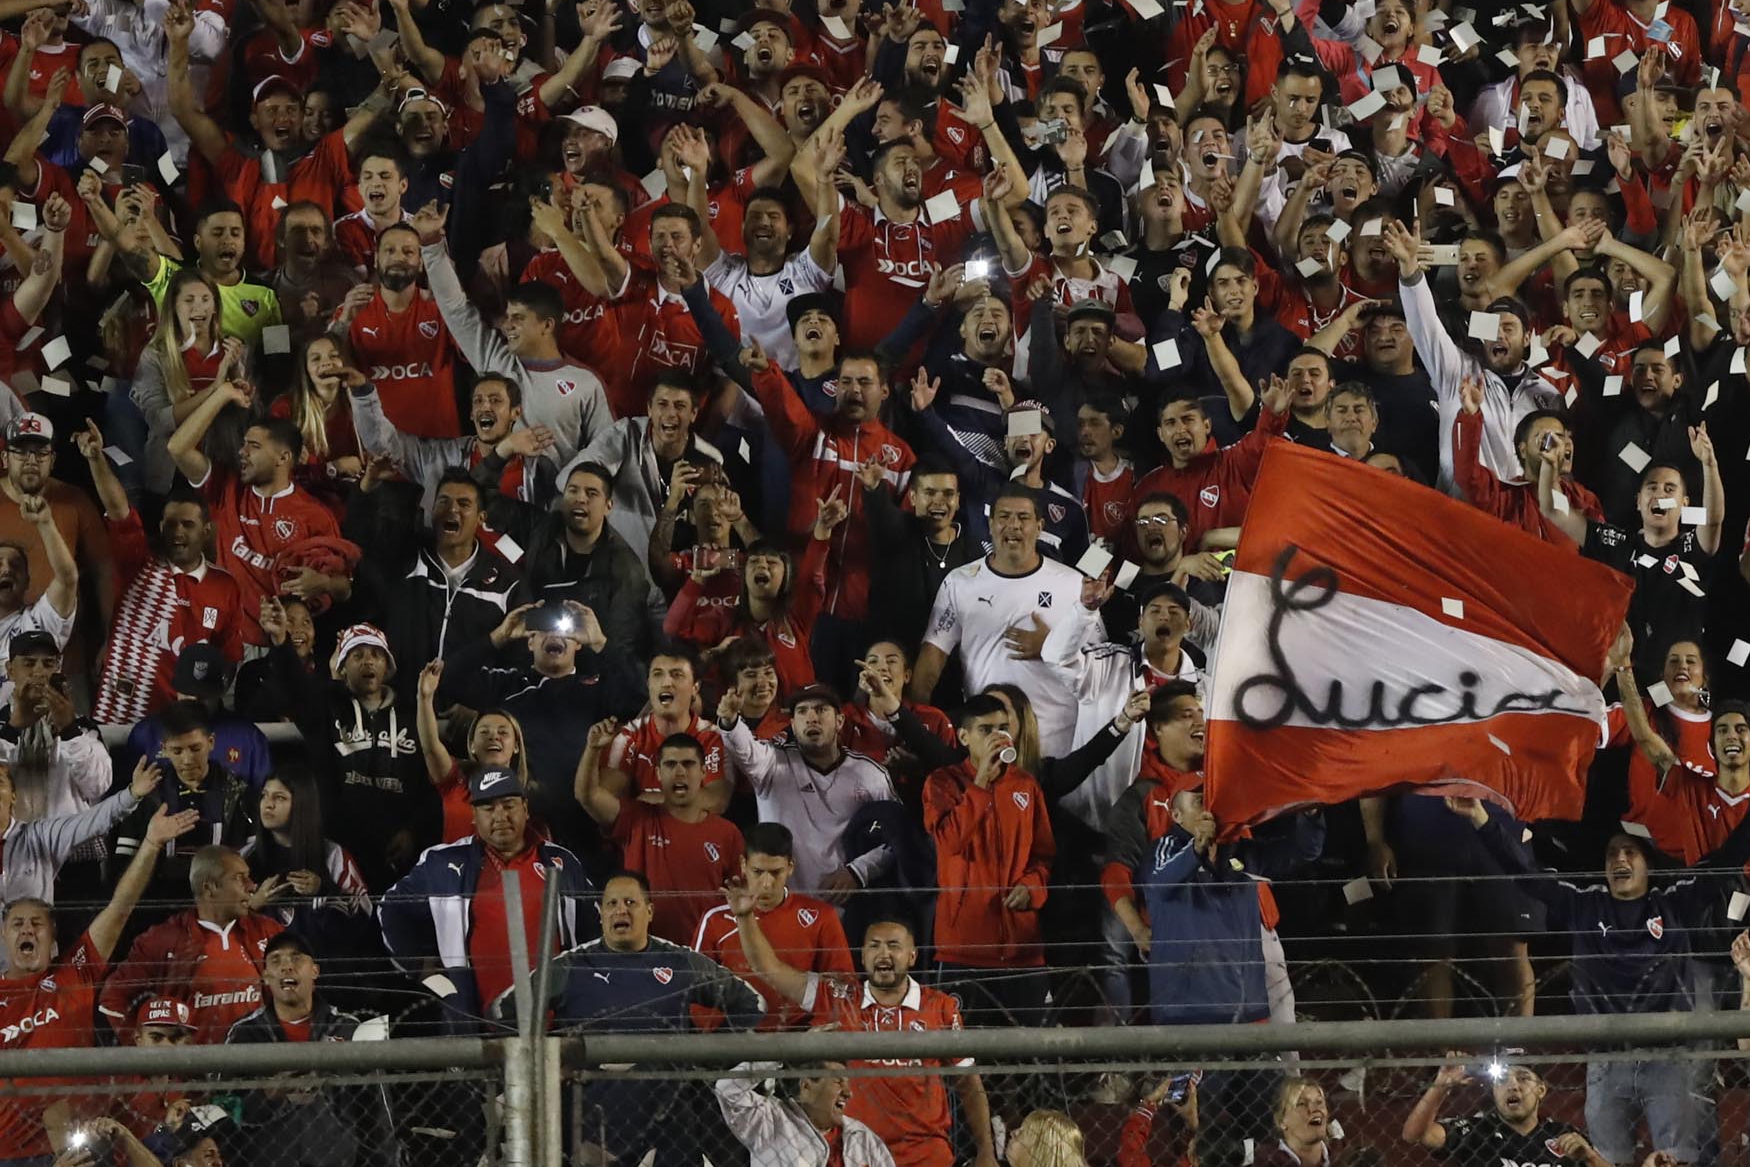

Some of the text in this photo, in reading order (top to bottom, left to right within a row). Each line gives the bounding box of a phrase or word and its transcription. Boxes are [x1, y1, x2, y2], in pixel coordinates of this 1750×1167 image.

[570, 304, 604, 323] OCA
[391, 362, 433, 380] OCA
[483, 771, 503, 783] NIKE
[194, 984, 260, 1009] taranto
[20, 1007, 60, 1033] OCA
[149, 1008, 171, 1020] COPAS
